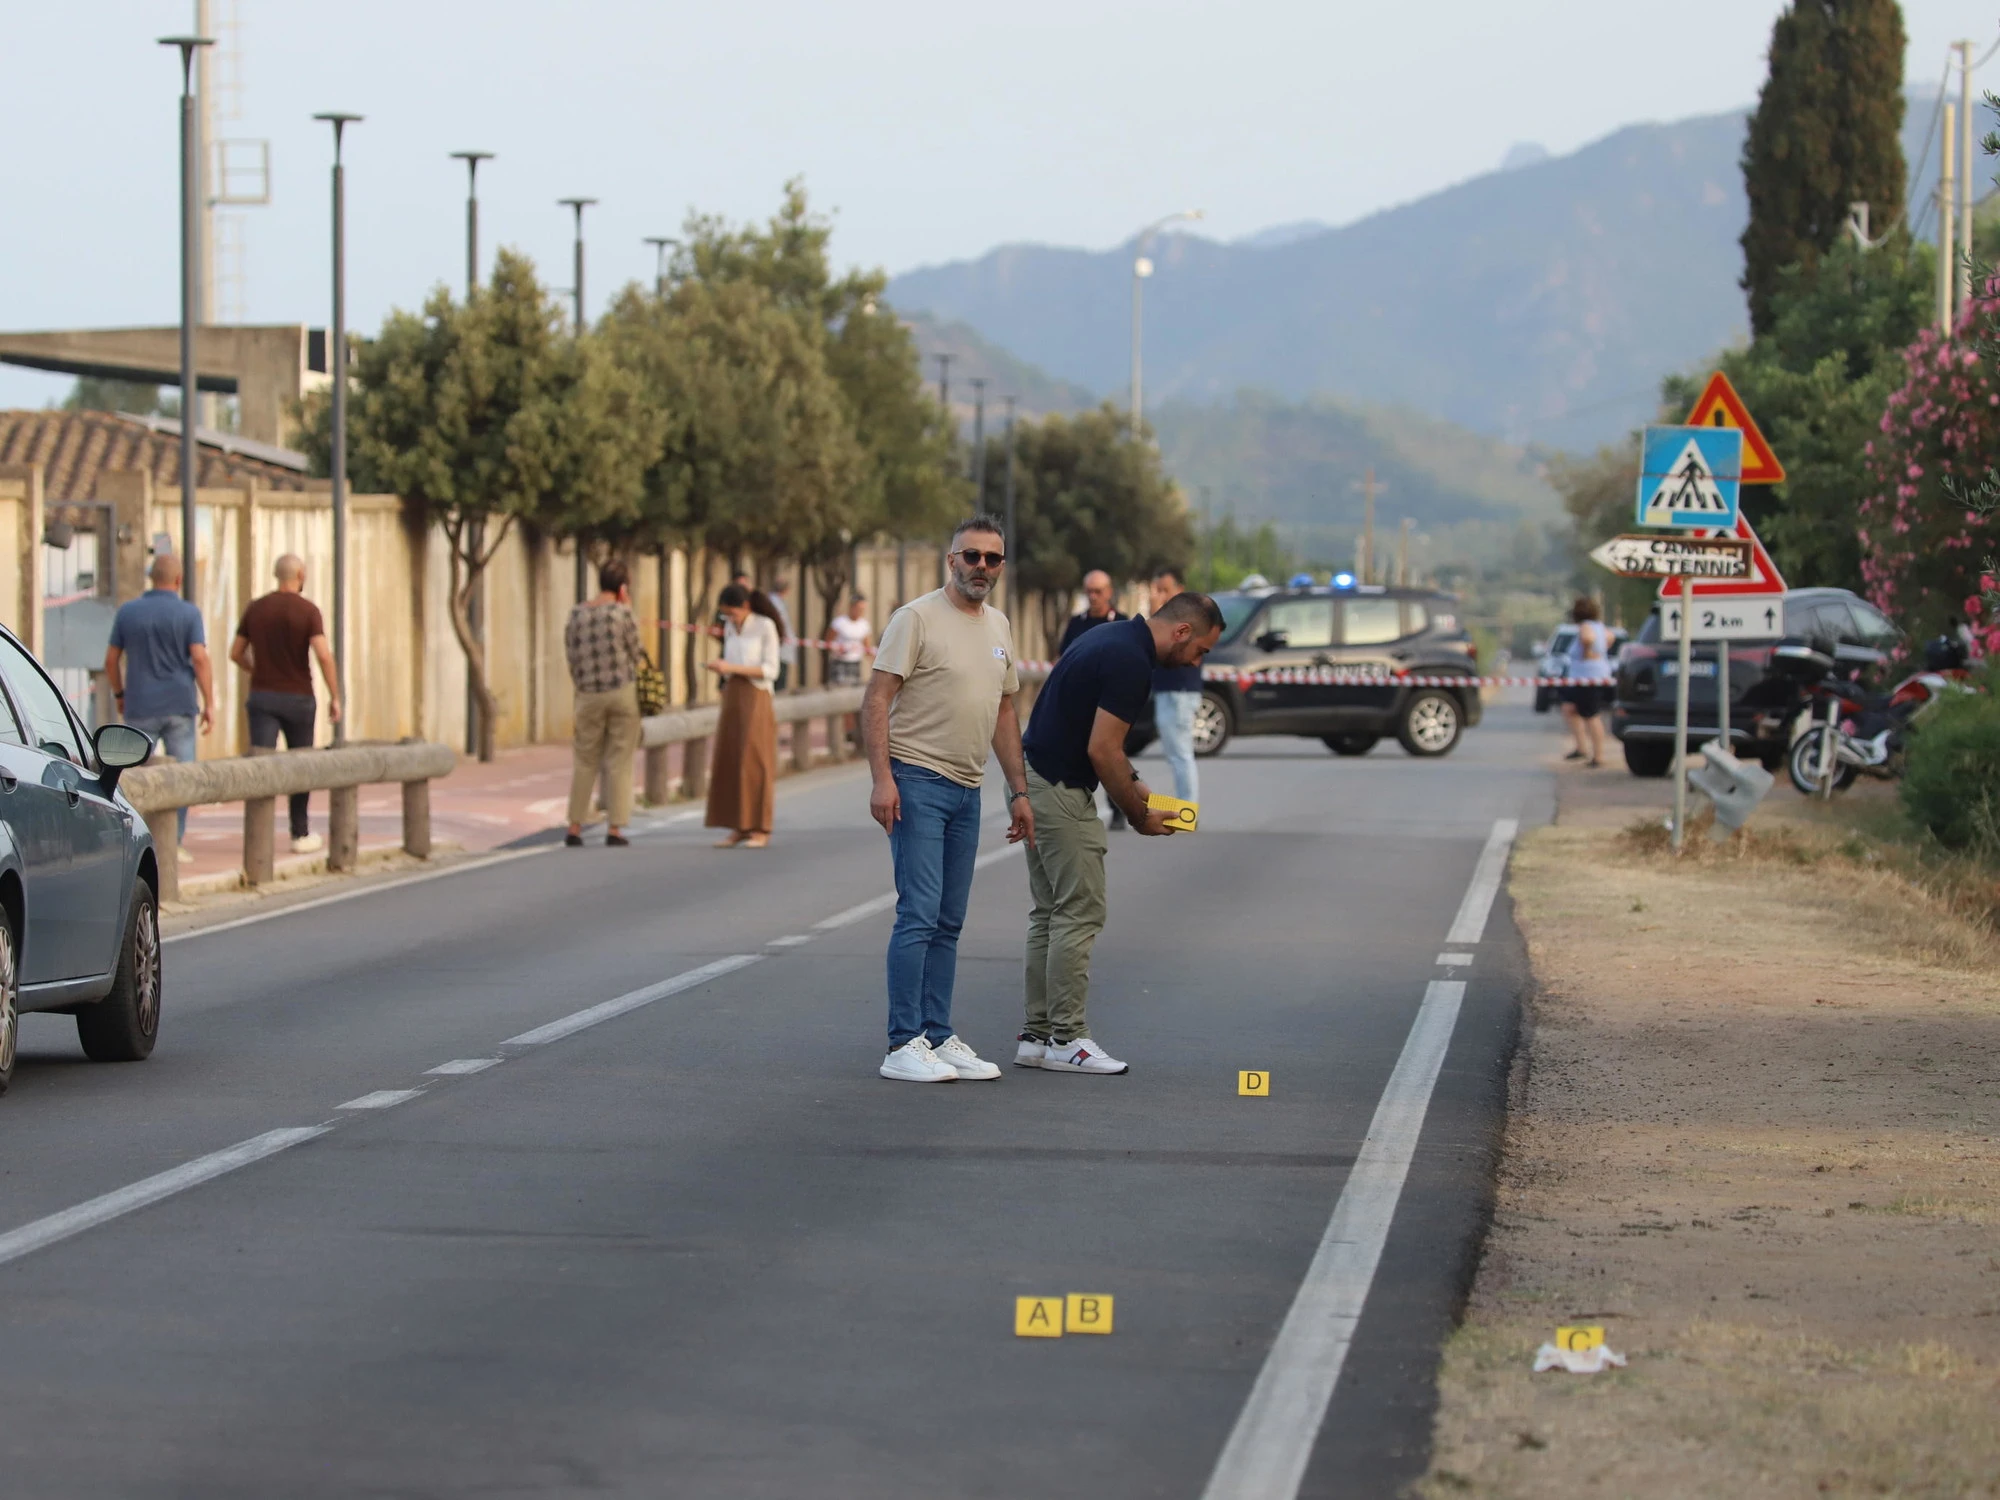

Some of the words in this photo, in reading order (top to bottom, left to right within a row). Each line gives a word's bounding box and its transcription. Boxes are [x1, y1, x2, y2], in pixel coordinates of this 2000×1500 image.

[1625, 556, 1656, 573] DA
[1667, 559, 1746, 577] TENNIS
[1703, 611, 1715, 627] 2
[1721, 617, 1742, 627] km
[1247, 1072, 1261, 1089] D
[1028, 1301, 1049, 1327] A
[1080, 1298, 1100, 1323] B
[1568, 1329, 1591, 1352] C
